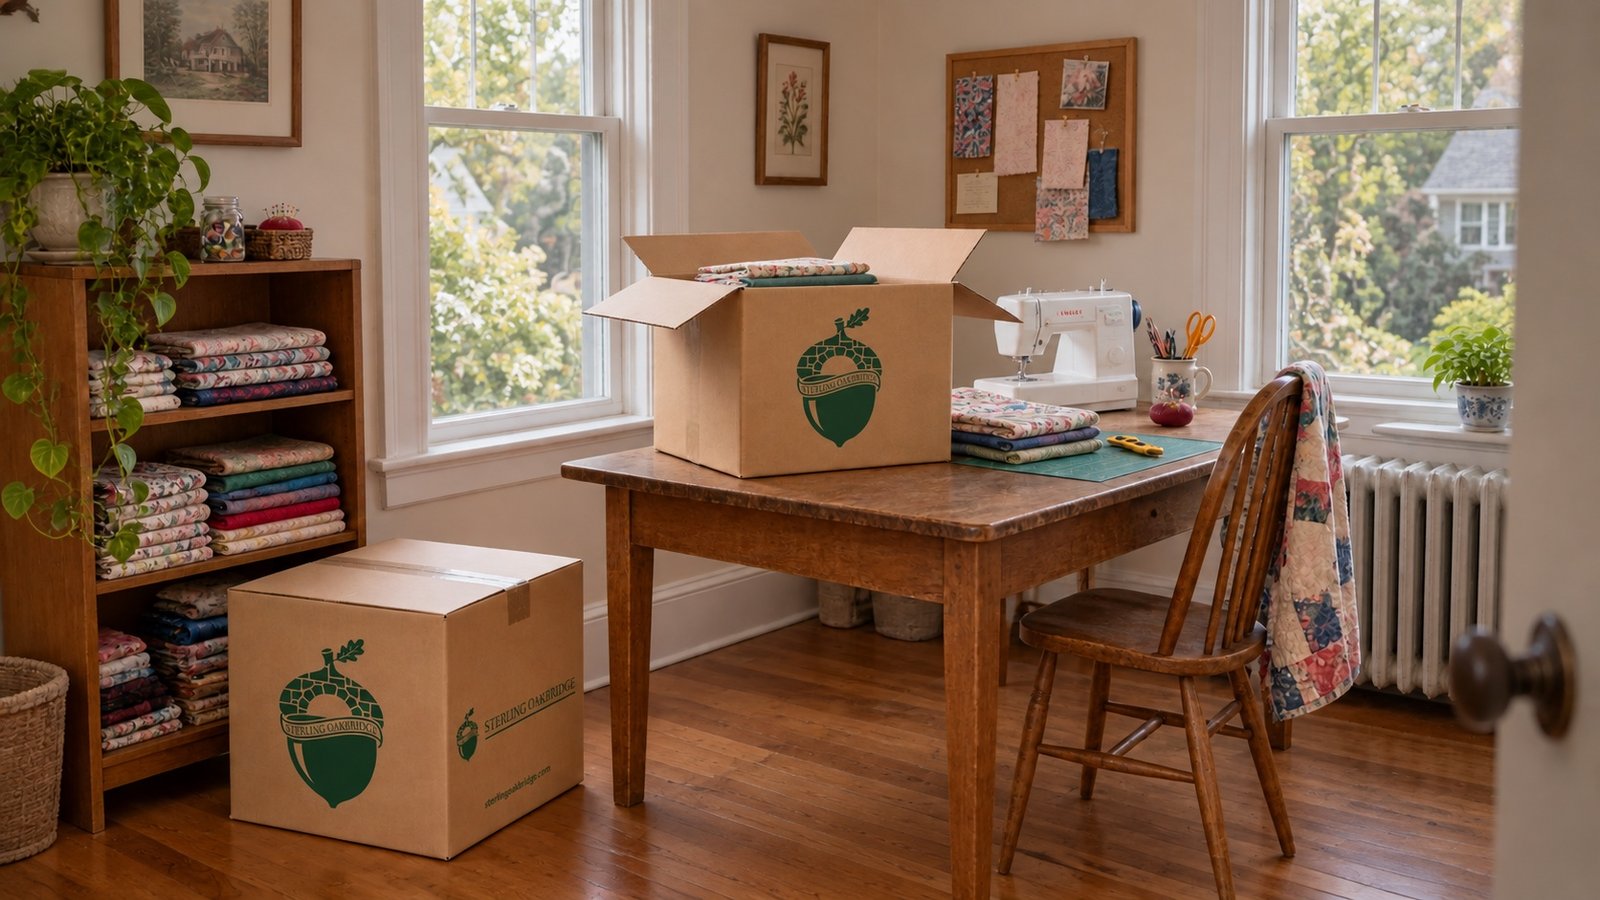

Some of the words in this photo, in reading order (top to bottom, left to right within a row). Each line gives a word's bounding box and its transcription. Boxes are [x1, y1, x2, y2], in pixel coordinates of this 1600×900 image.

[484, 702, 527, 733] STERLING
[527, 677, 576, 710] OAKBRIDGE
[285, 723, 326, 736] STERLING
[326, 720, 377, 735] OAKBRIDGE
